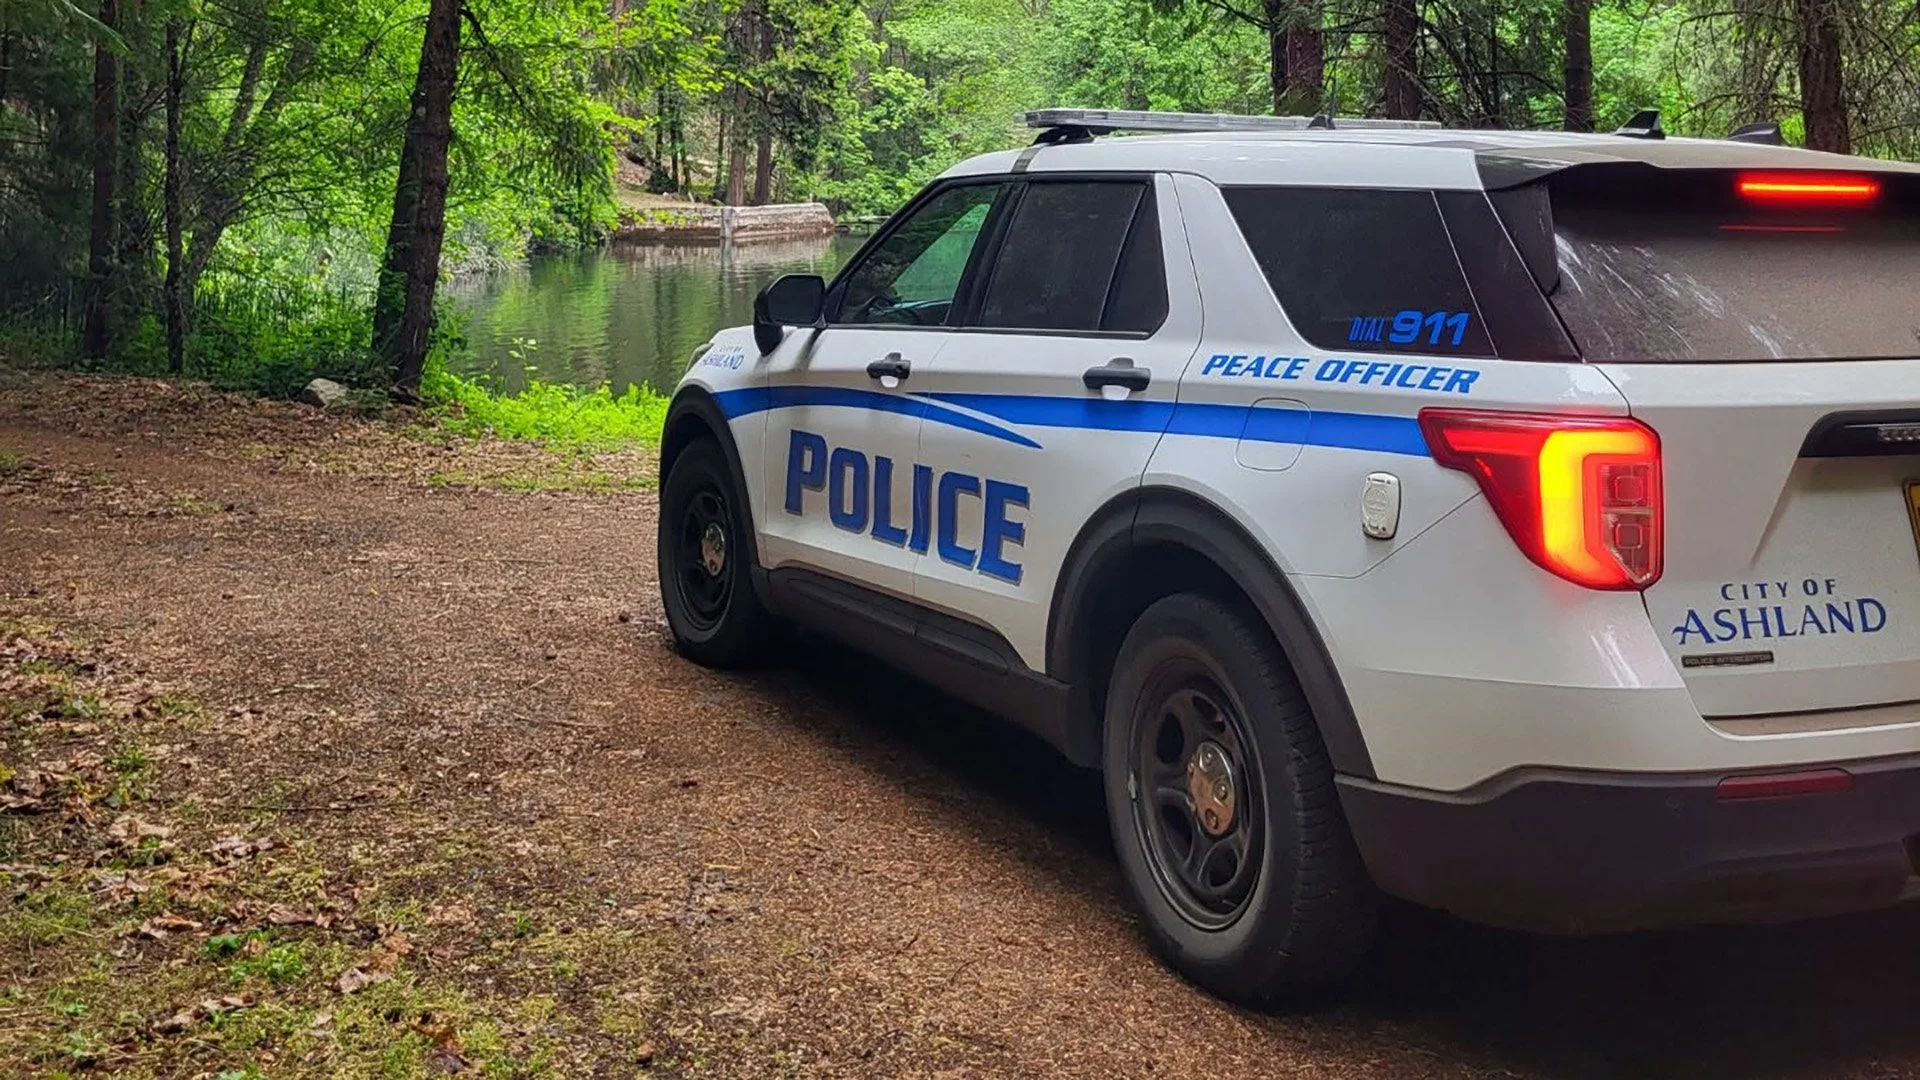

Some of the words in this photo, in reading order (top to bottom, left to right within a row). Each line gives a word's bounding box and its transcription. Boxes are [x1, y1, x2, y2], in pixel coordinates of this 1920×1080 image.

[1347, 315, 1386, 343] DIAL
[1389, 310, 1470, 346] 911
[1201, 355, 1310, 380] PEACE
[1315, 359, 1480, 394] OFFICER
[785, 429, 1030, 586] POLICE
[1721, 583, 1788, 601] CITY
[1803, 578, 1836, 596] OF
[1672, 598, 1887, 645] ASHLAND
